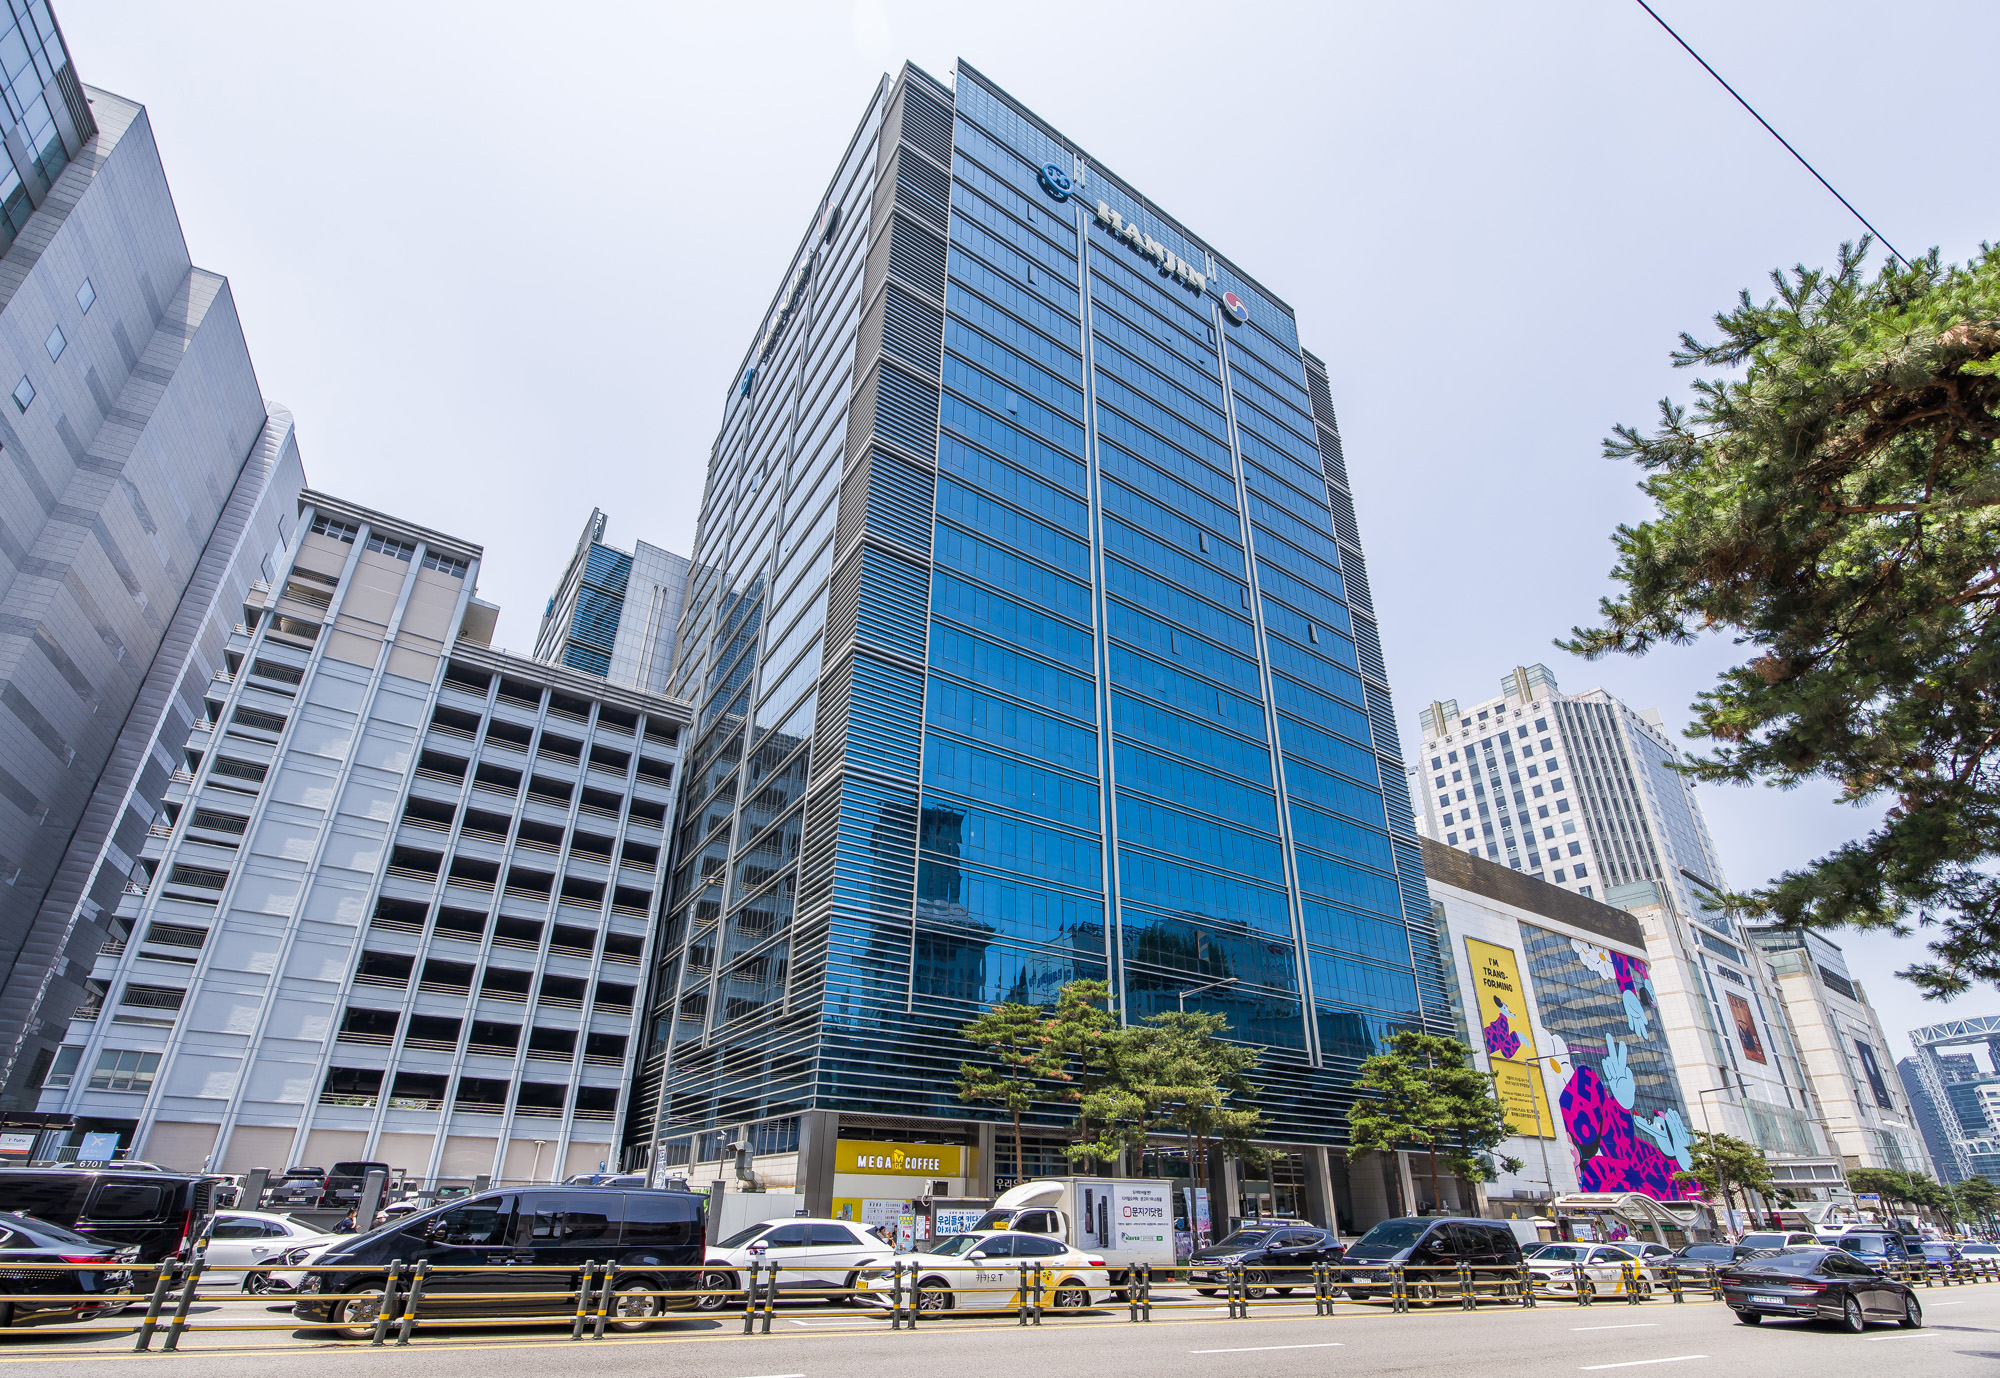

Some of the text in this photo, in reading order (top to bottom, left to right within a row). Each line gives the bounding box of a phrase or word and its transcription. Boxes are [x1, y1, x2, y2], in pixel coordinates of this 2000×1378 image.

[1097, 199, 1207, 292] HANJIN
[1488, 957, 1499, 968] I'M
[1482, 966, 1509, 980] TRANS-
[1482, 977, 1513, 992] FORMING
[79, 1160, 103, 1168] 6701
[857, 1155, 940, 1171] MEGA COFFEE
[1132, 1207, 1162, 1217] 문지기닷컴
